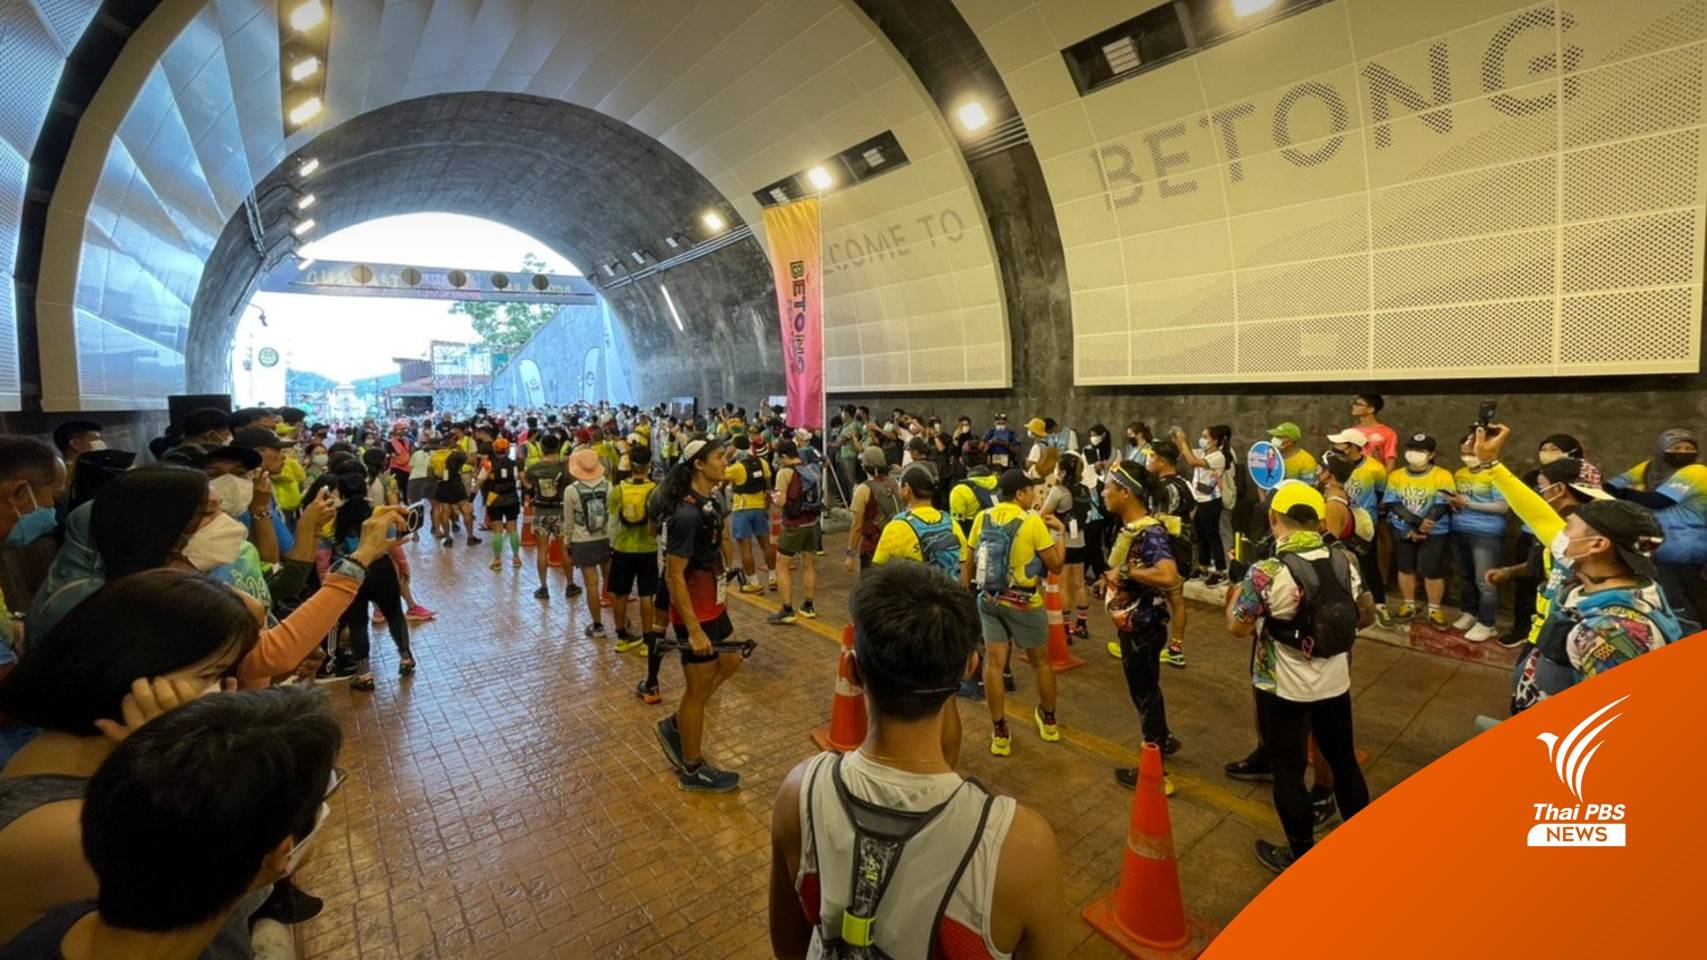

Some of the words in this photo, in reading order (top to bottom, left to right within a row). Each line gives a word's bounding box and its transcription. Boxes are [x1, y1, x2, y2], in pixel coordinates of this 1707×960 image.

[1090, 6, 1583, 210] BETONG
[917, 208, 964, 247] TO
[789, 260, 806, 375] BETONG
